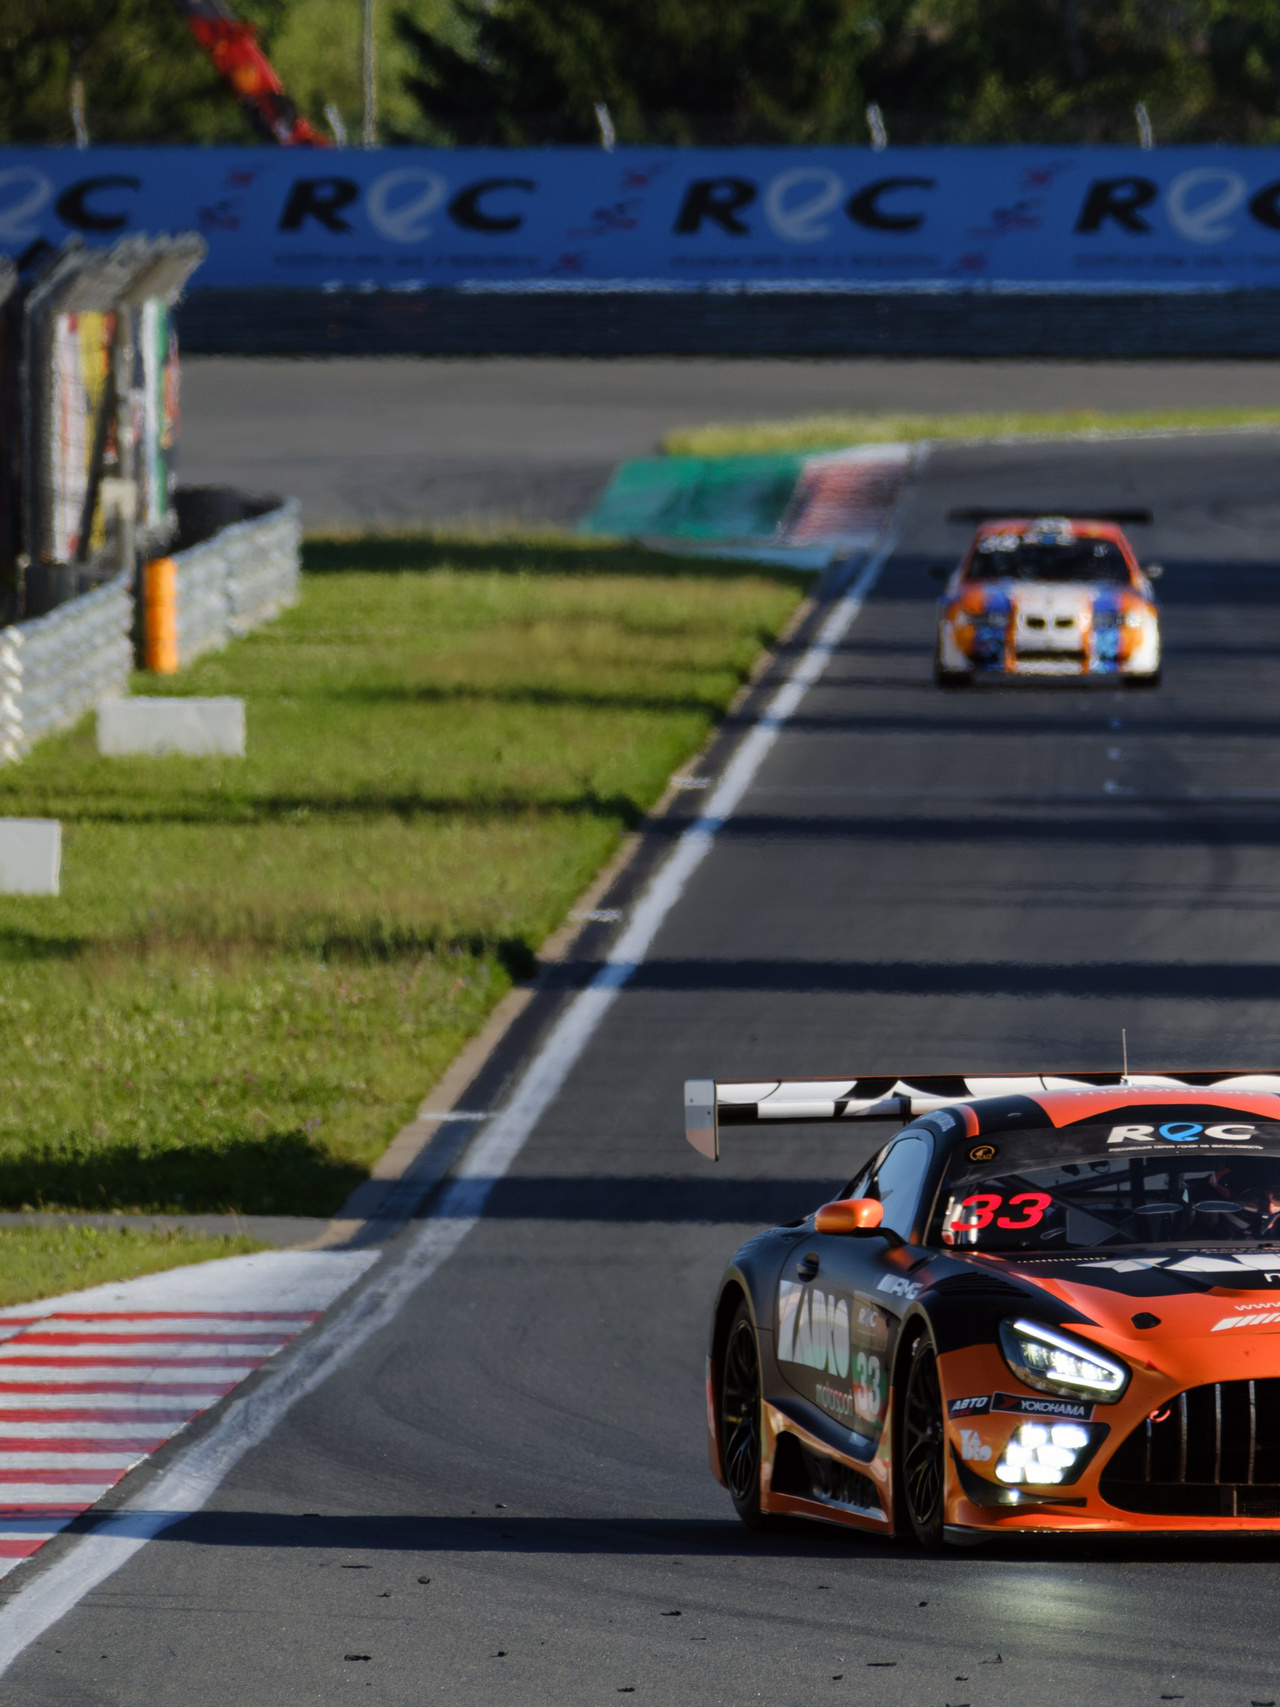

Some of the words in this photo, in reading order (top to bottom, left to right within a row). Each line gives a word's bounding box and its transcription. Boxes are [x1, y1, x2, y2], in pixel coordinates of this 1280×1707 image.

[950, 1193, 1052, 1231] 33
[855, 1352, 881, 1415] 33
[1020, 1400, 1085, 1416] YOKOHAMA
